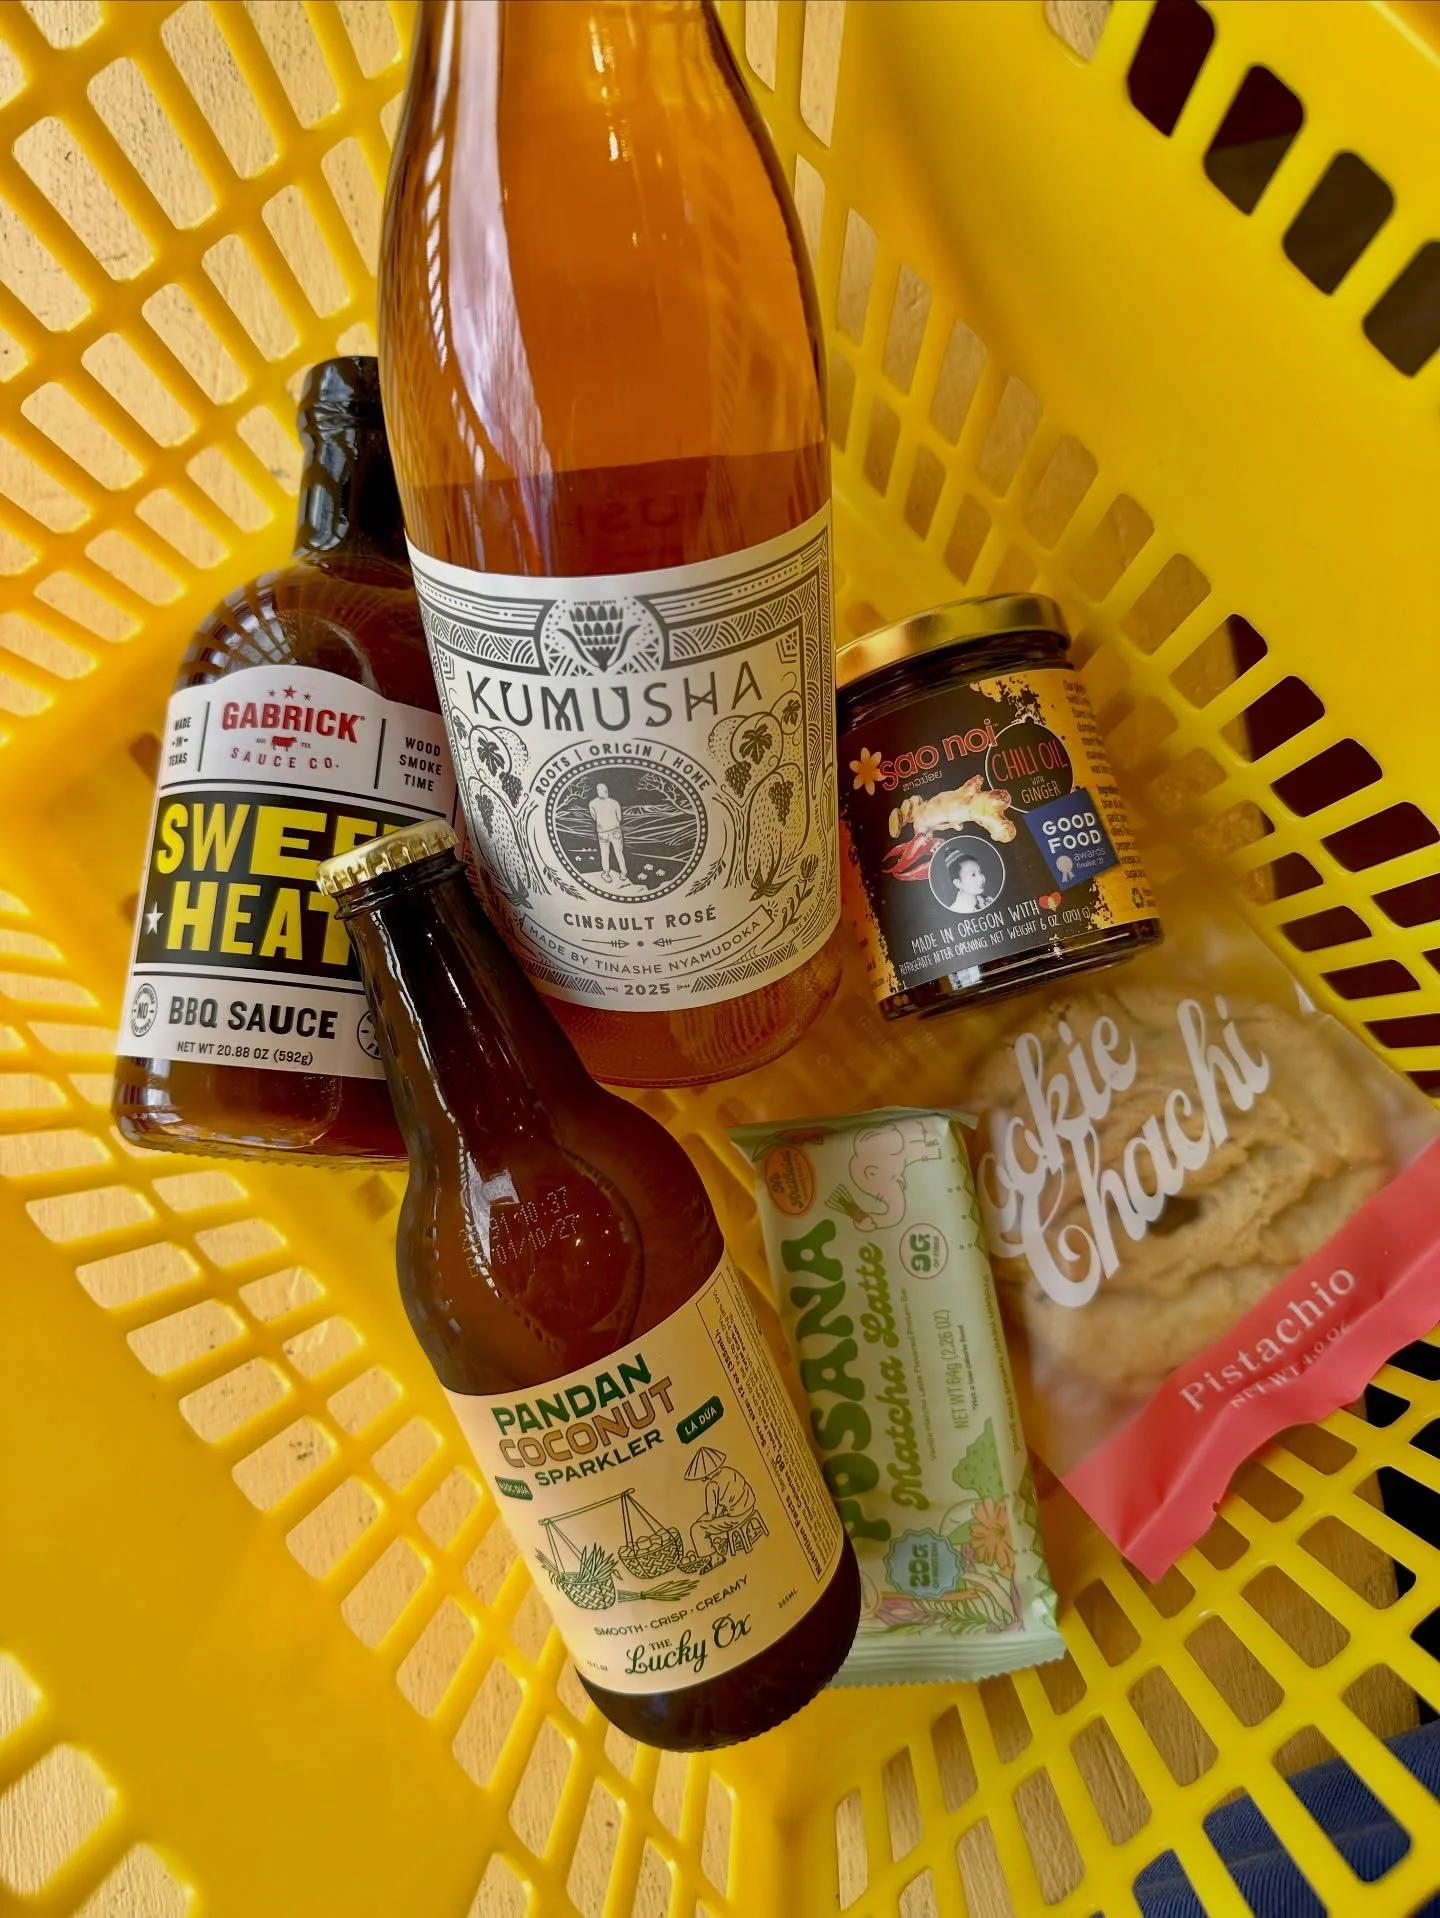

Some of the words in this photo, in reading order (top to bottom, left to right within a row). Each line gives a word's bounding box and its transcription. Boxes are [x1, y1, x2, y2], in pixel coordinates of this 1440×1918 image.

[466, 661, 762, 732] KUMUSHA
[174, 716, 192, 731] MADE
[222, 702, 361, 743] GABRICK
[168, 752, 188, 767] TEXAS
[231, 747, 297, 768] SAUCE
[309, 757, 340, 769] CO.
[399, 754, 442, 776] SMOKE
[405, 736, 441, 757] WOOD
[879, 745, 940, 791] sao
[941, 719, 999, 762] noi
[991, 745, 1038, 782] CHILI
[1038, 737, 1069, 770] OIL
[404, 774, 436, 792] TIME
[536, 756, 571, 796] ROOTS
[589, 742, 652, 758] ORIGIN
[673, 756, 710, 791] HOME
[1021, 780, 1061, 804] GINGER
[156, 803, 407, 881] SWE
[1043, 812, 1096, 836] GOOD
[1048, 829, 1101, 853] FOOD
[1073, 847, 1106, 862] awards
[166, 880, 351, 966] HEAT
[564, 912, 654, 931] CINSAULT
[665, 905, 717, 928] ROSÉ
[911, 932, 938, 956] MADE
[940, 927, 955, 944] IN
[957, 910, 1004, 938] OREGON
[1008, 899, 1041, 924] WITH
[529, 926, 565, 955] MADE
[571, 951, 589, 965] BY
[595, 959, 662, 974] TINASHE
[669, 920, 761, 971] NYAMUDOKA
[899, 954, 933, 976] REFRIGERATE
[933, 946, 953, 965] AFTER
[954, 936, 989, 956] OPENING
[990, 929, 1005, 947] NET
[1008, 920, 1037, 940] WEIGHT
[1039, 918, 1048, 931] 6
[1047, 914, 1060, 927] OZ
[624, 983, 671, 995] 2025
[137, 1002, 149, 1019] NO
[168, 995, 219, 1028] BBQ
[228, 1000, 339, 1040] SAUCE
[177, 1040, 195, 1053] NET
[198, 1043, 215, 1056] WT
[217, 1045, 250, 1059] 20.88
[253, 1047, 270, 1060] OZ
[273, 1048, 313, 1067] (592g)
[978, 1016, 1137, 1232] ookie
[1018, 996, 1270, 1308] Chachi
[908, 1233, 931, 1271] 9G
[855, 1241, 899, 1348] Latte
[933, 1309, 952, 1329] OZ)
[939, 1331, 958, 1361] (2.26
[1179, 1269, 1355, 1412] Pistachio
[732, 1373, 740, 1384] oz
[738, 1386, 745, 1399] 12
[945, 1362, 963, 1385] 64g
[1231, 1382, 1267, 1408] NET
[1267, 1363, 1300, 1387] WT
[491, 1353, 652, 1436] PANDAN
[947, 1386, 965, 1406] WT
[499, 1376, 673, 1468] COCONUT
[684, 1419, 698, 1435] LÁ
[755, 1421, 767, 1448] Serv.
[876, 1356, 930, 1511] Matcha
[951, 1408, 969, 1429] NET
[534, 1429, 666, 1486] SPARKLER
[785, 1470, 802, 1509] Calories
[785, 1494, 801, 1528] Facts
[799, 1527, 822, 1576] Nutrition
[907, 1543, 930, 1587] 20G
[594, 1623, 643, 1637] SMOOTH
[650, 1609, 688, 1630] CRISP
[696, 1575, 749, 1612] CREAMY
[624, 1630, 708, 1675] Lucky
[712, 1612, 752, 1649] Ox
[649, 1638, 673, 1652] THE
